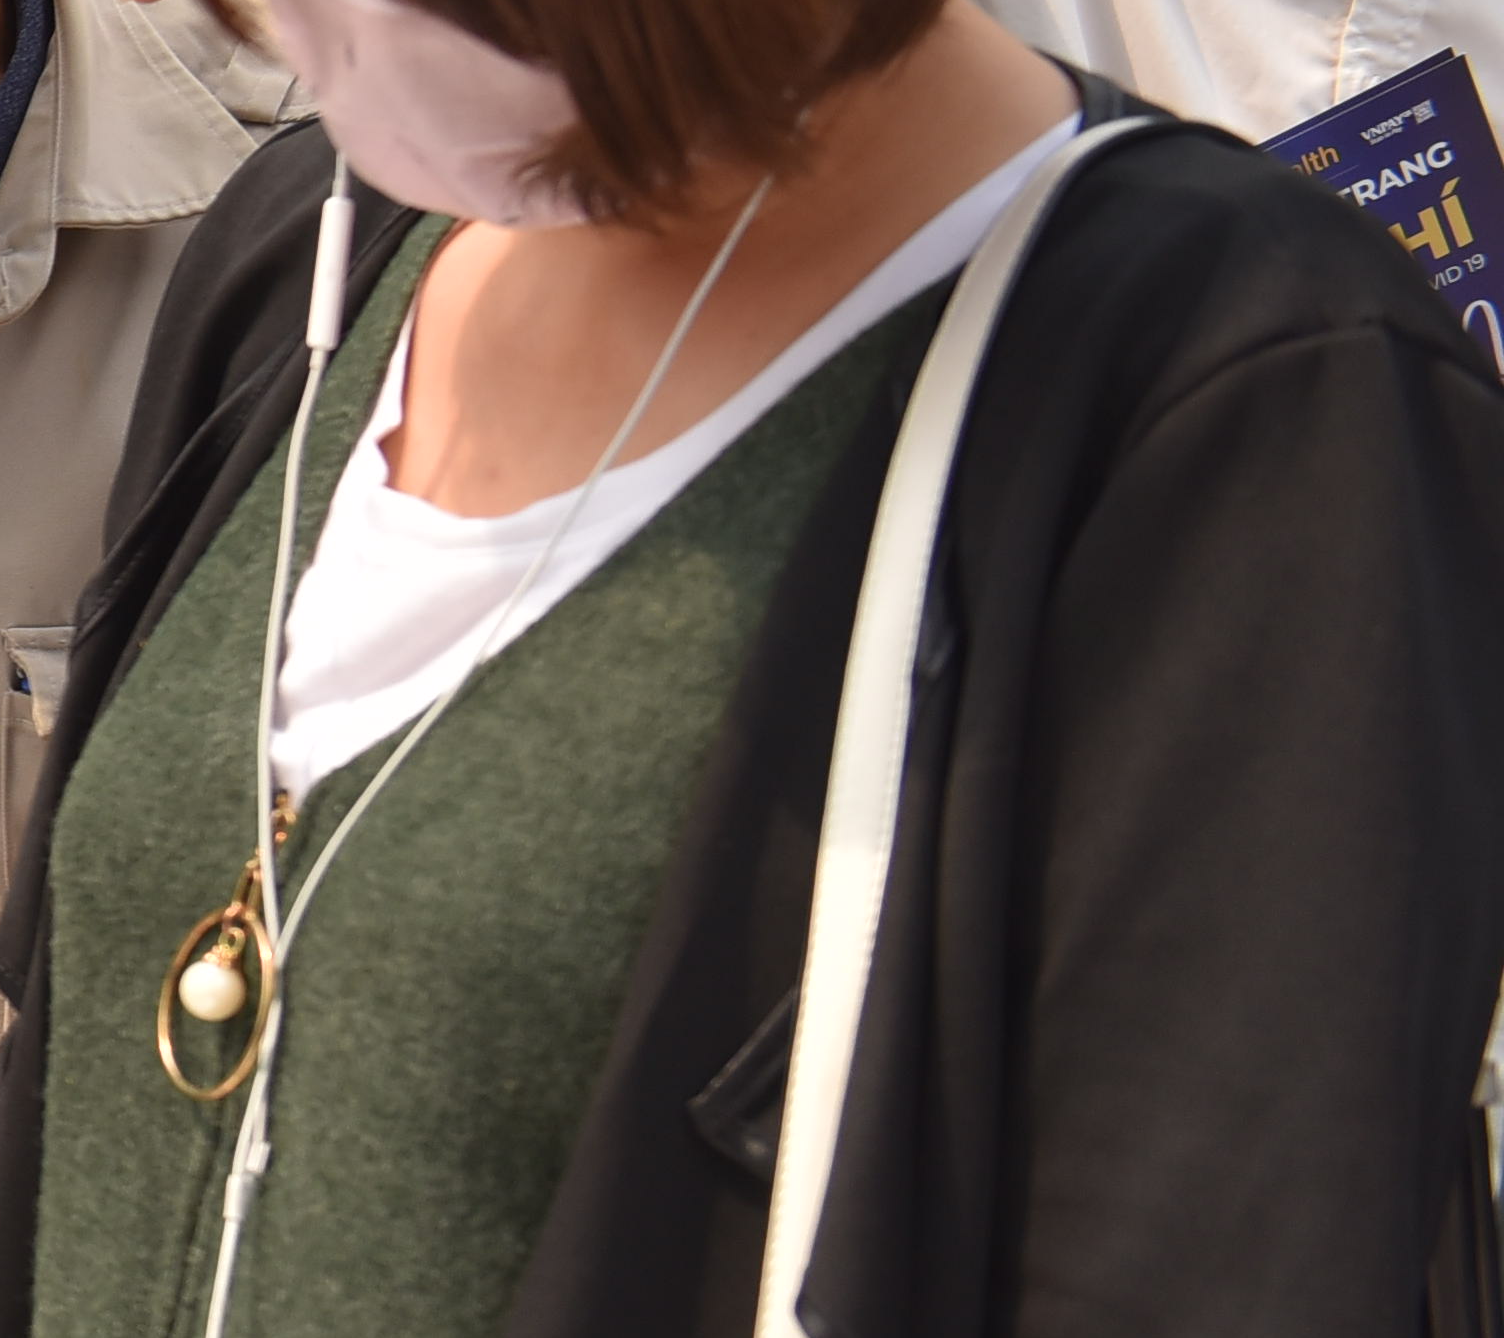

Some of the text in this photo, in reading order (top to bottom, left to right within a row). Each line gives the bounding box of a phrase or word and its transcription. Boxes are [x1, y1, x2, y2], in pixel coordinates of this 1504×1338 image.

[1388, 177, 1474, 259] HÍ
[1428, 253, 1486, 290] VID 19
